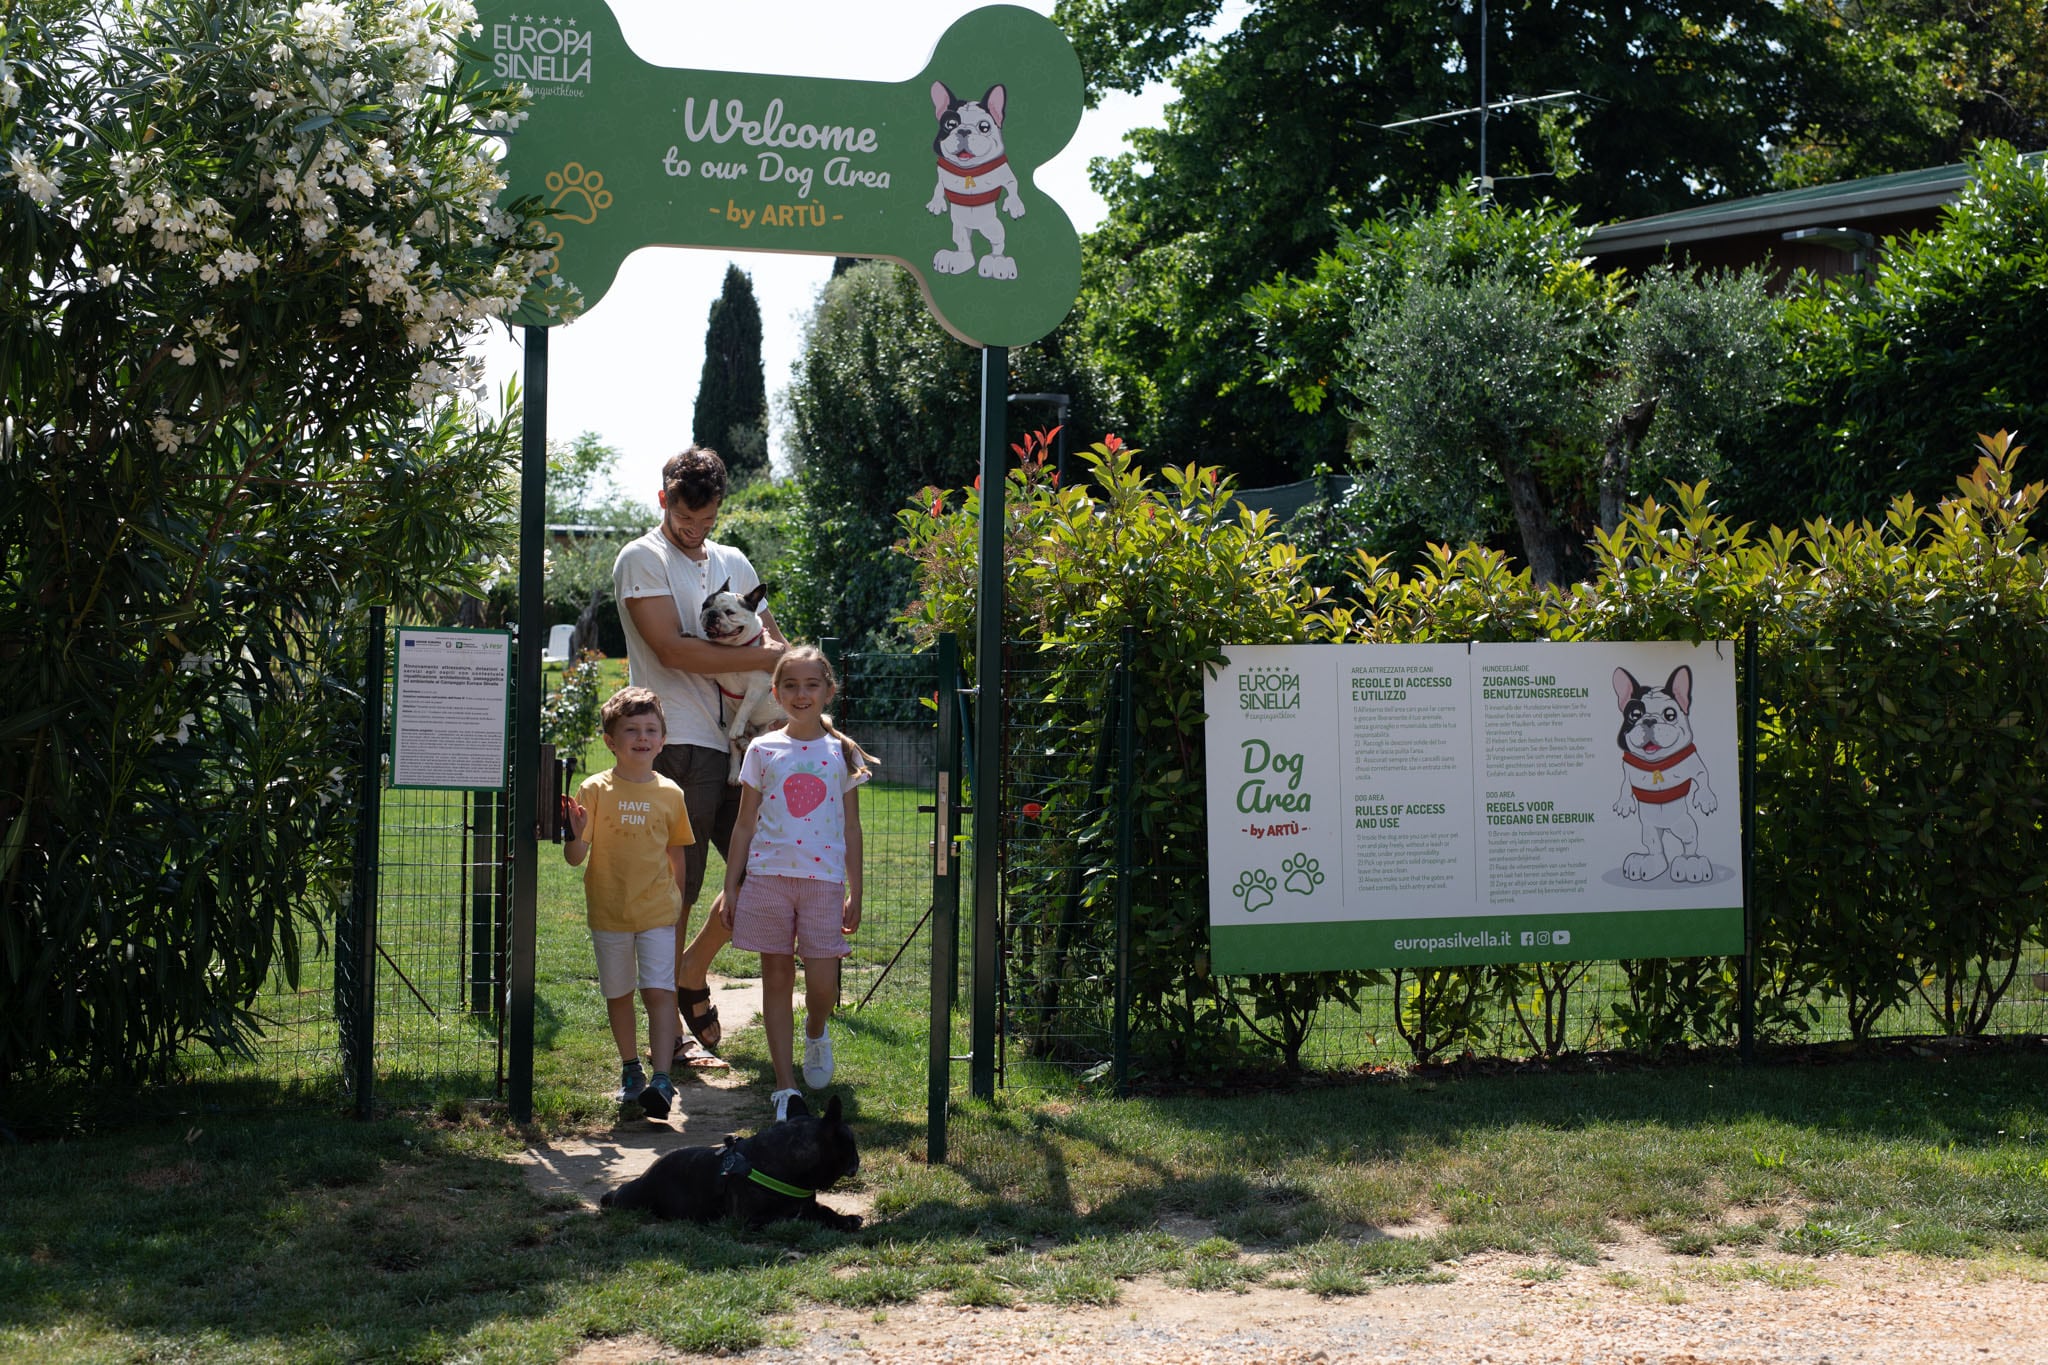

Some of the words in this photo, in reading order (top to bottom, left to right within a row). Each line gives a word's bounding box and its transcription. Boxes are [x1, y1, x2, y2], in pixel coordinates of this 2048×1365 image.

[494, 24, 592, 56] EUROPA
[685, 97, 878, 153] Welcome
[663, 146, 691, 176] to
[701, 161, 748, 180] our
[758, 152, 814, 198] Dog
[824, 157, 890, 188] Area
[727, 200, 755, 229] by
[761, 199, 825, 227] ARTÙ
[1239, 674, 1300, 691] EUROPA
[1352, 678, 1391, 688] REGOLE
[1394, 678, 1403, 688] DI
[1406, 677, 1452, 687] ACCESSO
[1483, 676, 1556, 686] ZUGANGS-UND
[1352, 691, 1358, 701] E
[1361, 690, 1406, 701] UTILIZZO
[1483, 688, 1589, 699] BENUTZUNGSREGELN
[1241, 739, 1304, 790] Dog
[1237, 779, 1311, 813] Area
[618, 801, 650, 812] HAVE
[1356, 805, 1388, 816] RULES
[1391, 805, 1404, 815] OF
[1406, 804, 1445, 815] ACCESS
[1486, 802, 1524, 813] REGELS
[1526, 801, 1554, 812] VOOR
[621, 815, 646, 825] FUN
[1355, 819, 1377, 828] AND
[1380, 818, 1400, 828] USE
[1487, 814, 1533, 825] TOEGANG
[1536, 814, 1549, 824] EN
[1552, 813, 1595, 823] GEBRUIK
[1250, 824, 1265, 839] by
[1267, 820, 1299, 836] ARTÙ
[1394, 931, 1512, 952] europasilvella.it
